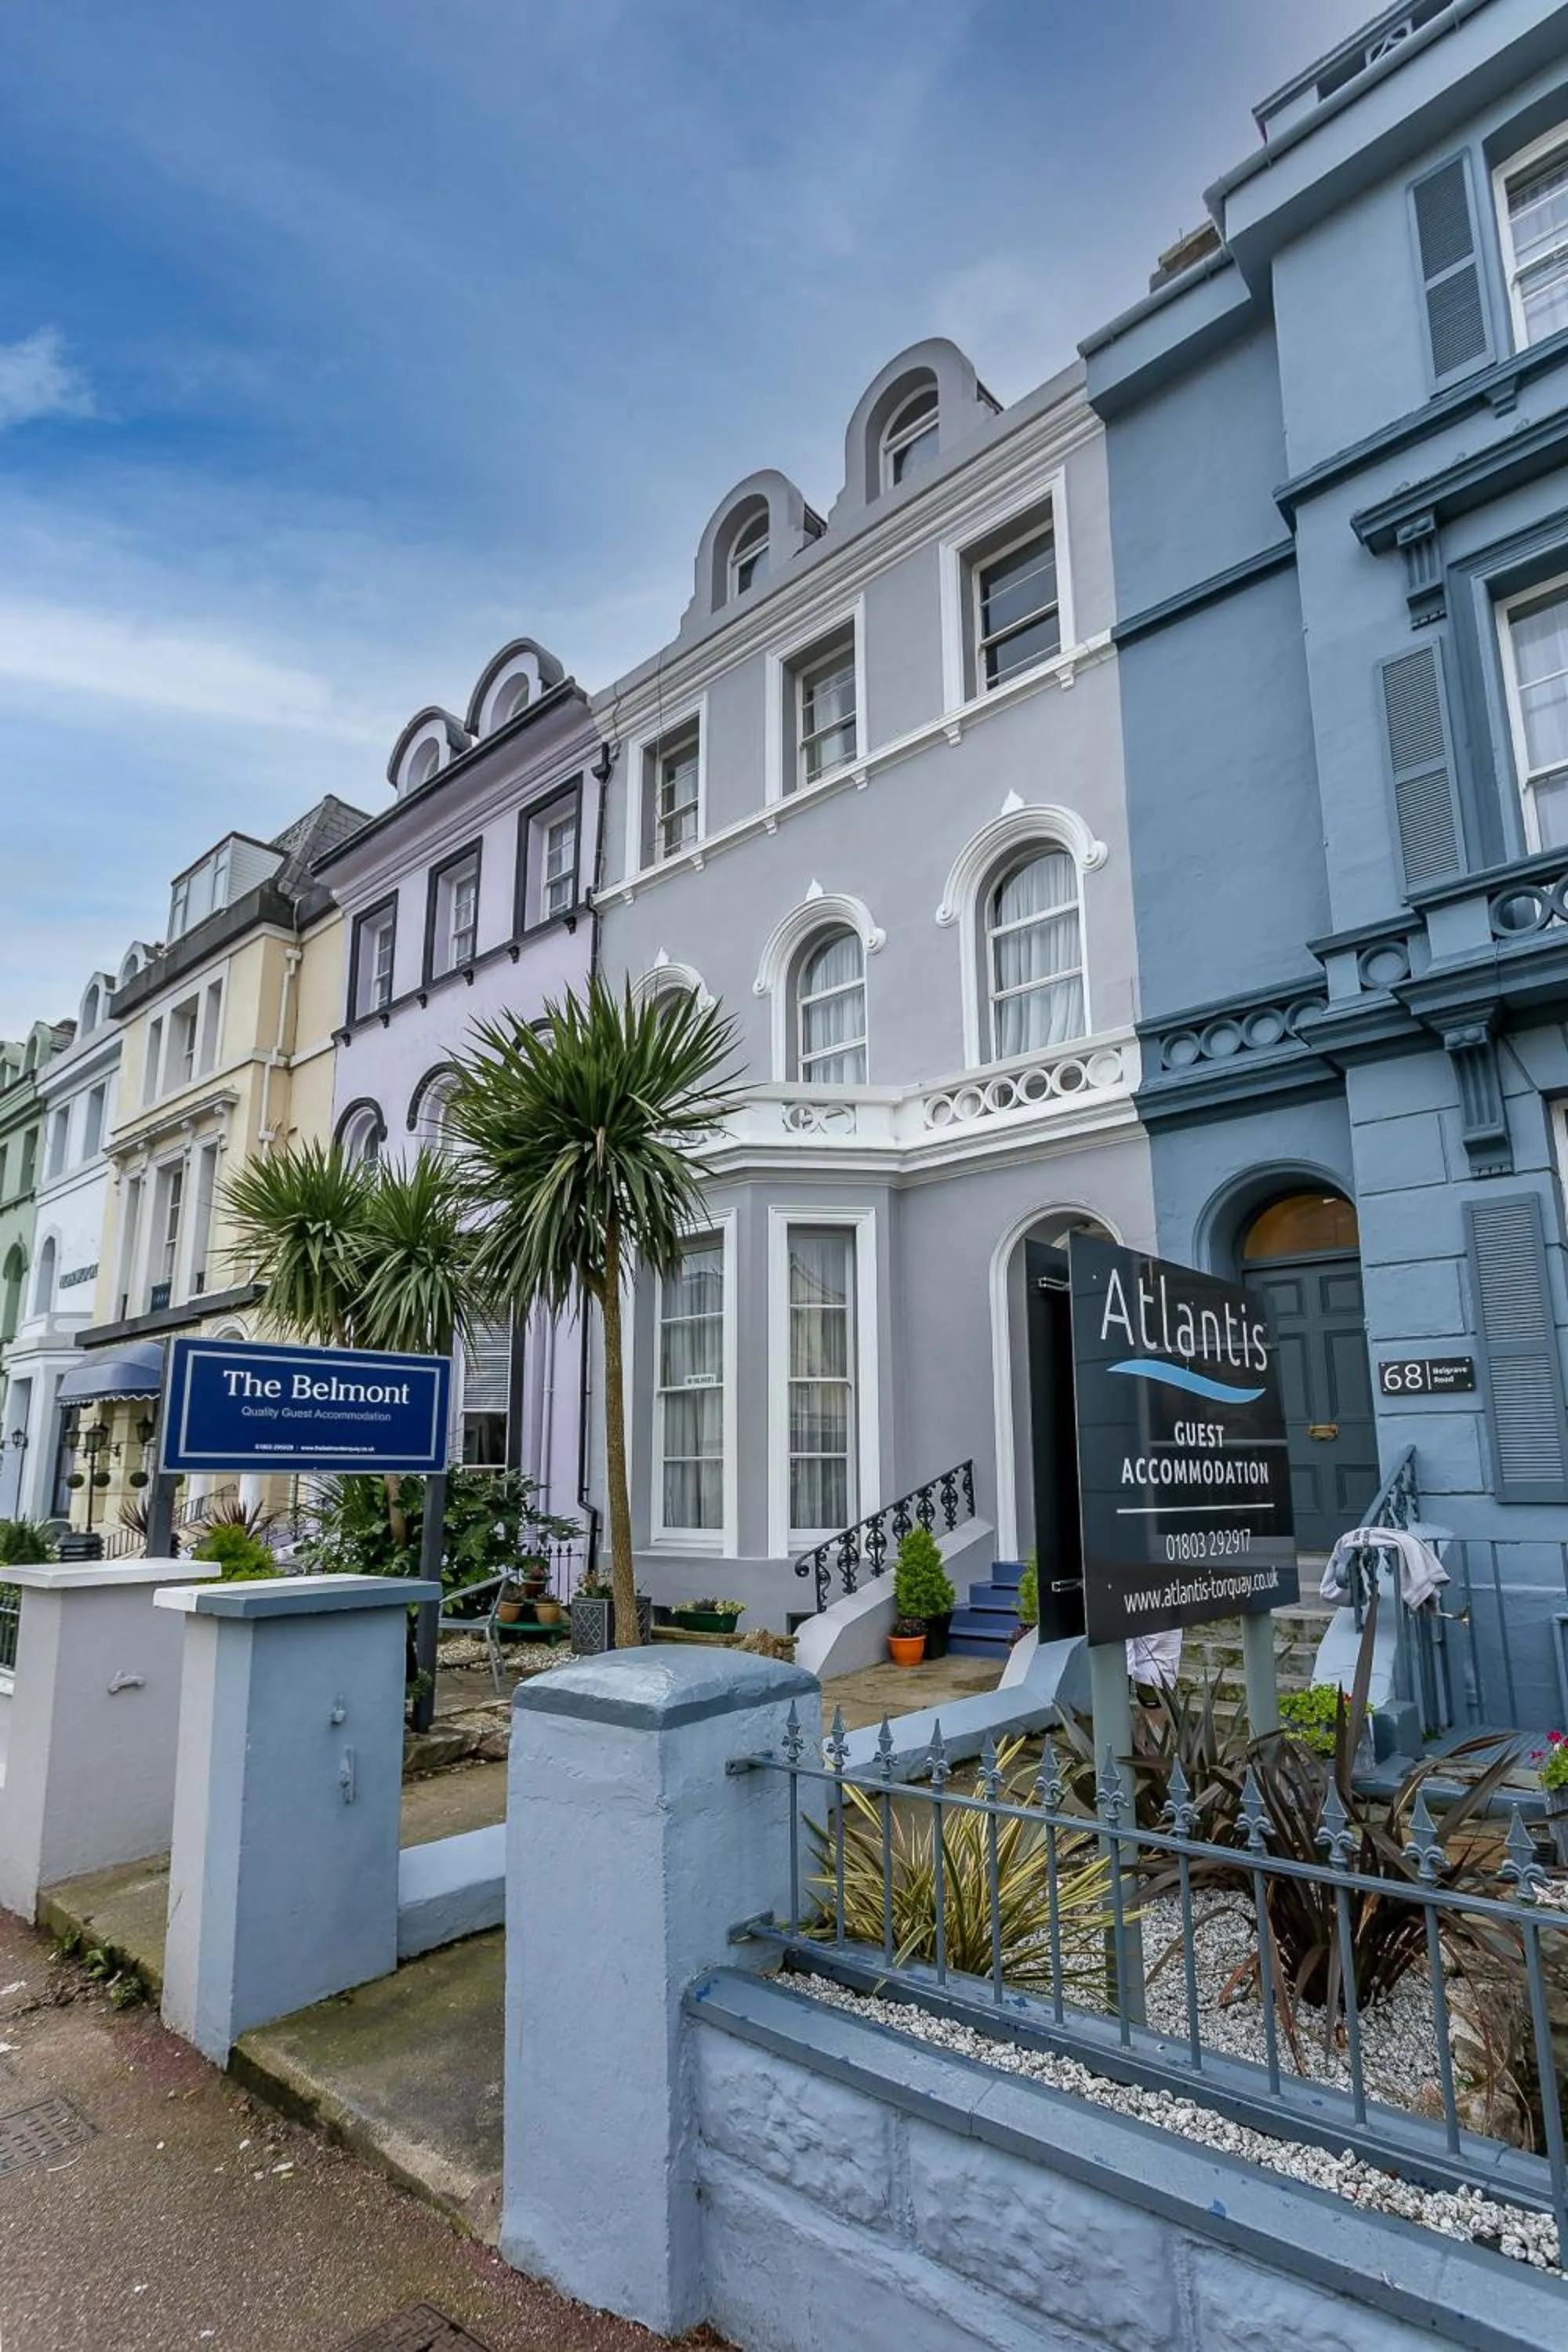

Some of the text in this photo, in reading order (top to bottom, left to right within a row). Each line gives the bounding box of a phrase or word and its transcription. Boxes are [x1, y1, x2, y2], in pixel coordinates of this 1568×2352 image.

[1100, 1269, 1268, 1371] Atlantis
[223, 1370, 410, 1404] The Belmont
[1384, 1363, 1423, 1390] 68
[1434, 1375, 1454, 1384] Road
[241, 1406, 391, 1421] Quality Guest Accommodation
[1174, 1421, 1224, 1447] GUEST
[1122, 1457, 1269, 1485] ACCOMMODATION
[1166, 1529, 1250, 1561] 01803 292917
[1123, 1565, 1279, 1613] www.atlantis-torquay.co.uk
